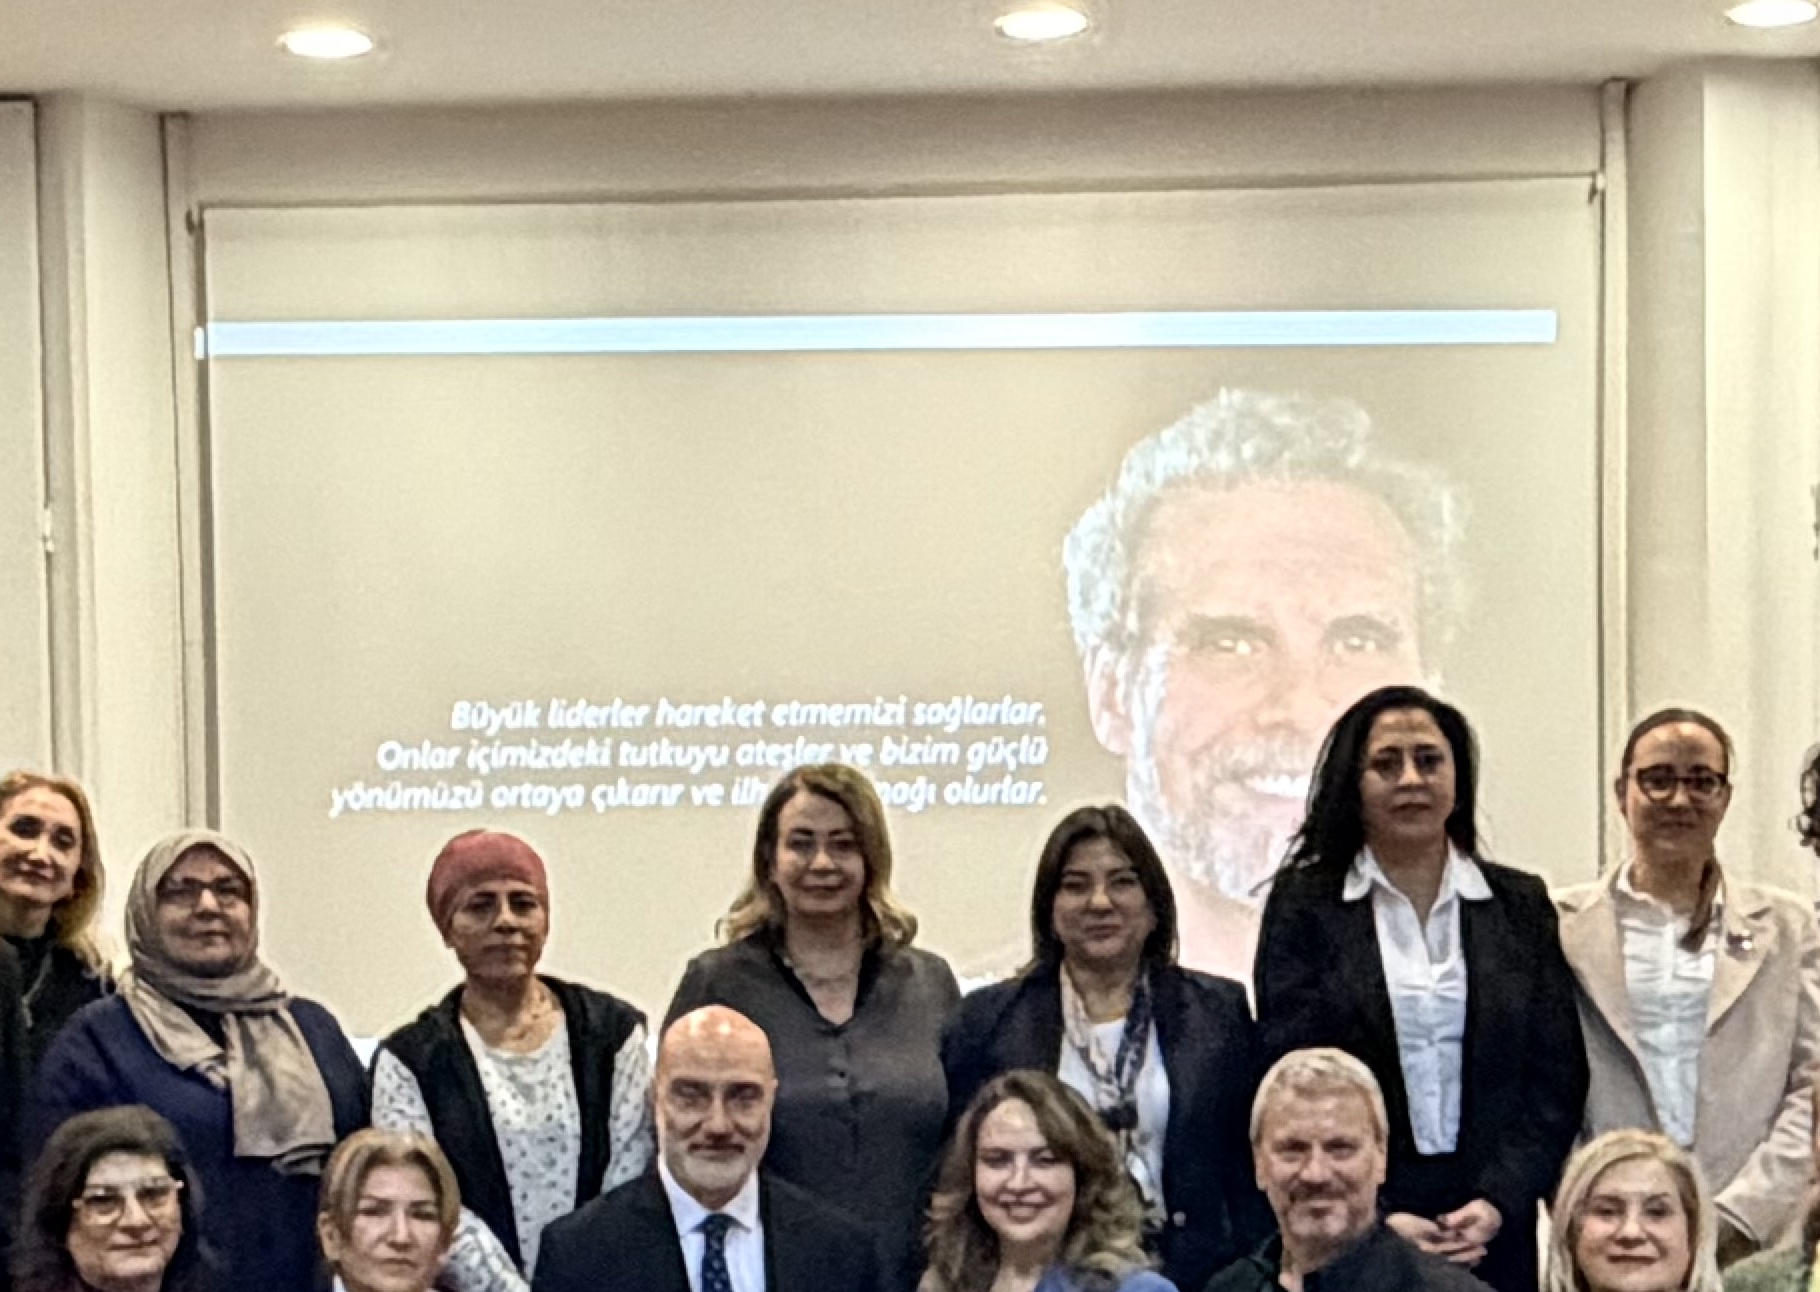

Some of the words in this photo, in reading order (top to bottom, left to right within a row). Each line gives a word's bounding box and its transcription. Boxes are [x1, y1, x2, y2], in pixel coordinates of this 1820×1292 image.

[450, 699, 541, 736] Büyük
[547, 697, 650, 728] liderler
[655, 696, 766, 728] hareket
[772, 695, 906, 728] etmemizi
[913, 694, 1047, 732] sağlarlar.
[377, 739, 461, 771] Onlar
[467, 738, 613, 774] içimizdeki
[619, 737, 729, 774] tutkuyu
[736, 736, 833, 770] ateşler
[839, 742, 874, 766] ve
[880, 735, 960, 766] bizim
[966, 736, 1048, 771] güçlü
[329, 779, 484, 818] yönümüzü
[491, 783, 584, 815] ortaya
[591, 777, 685, 813] çıkarır
[691, 783, 724, 806] ve
[731, 776, 768, 806] ilh
[943, 777, 1046, 807] olurlar.
